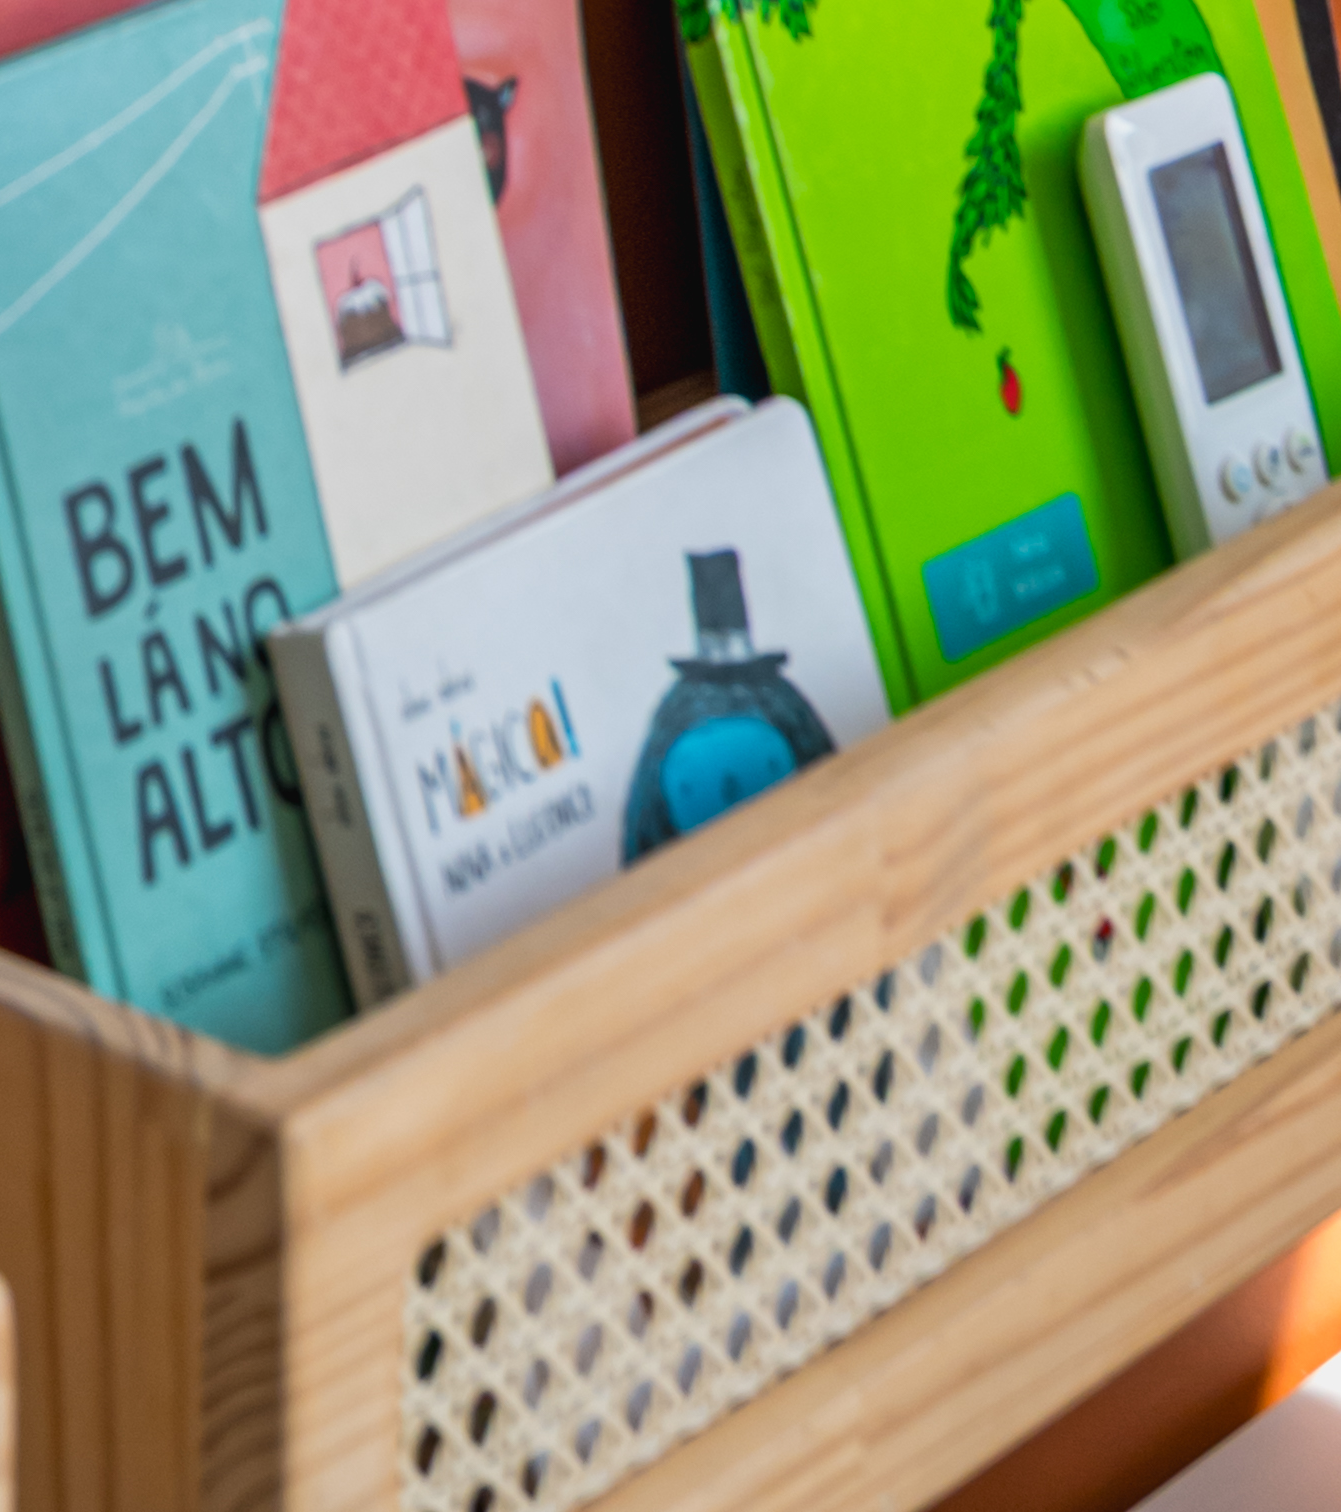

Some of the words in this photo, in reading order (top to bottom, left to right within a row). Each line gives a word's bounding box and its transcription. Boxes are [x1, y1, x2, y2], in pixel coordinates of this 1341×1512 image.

[62, 413, 270, 620] BEM
[97, 594, 193, 746] LÁ
[193, 577, 294, 699] NO
